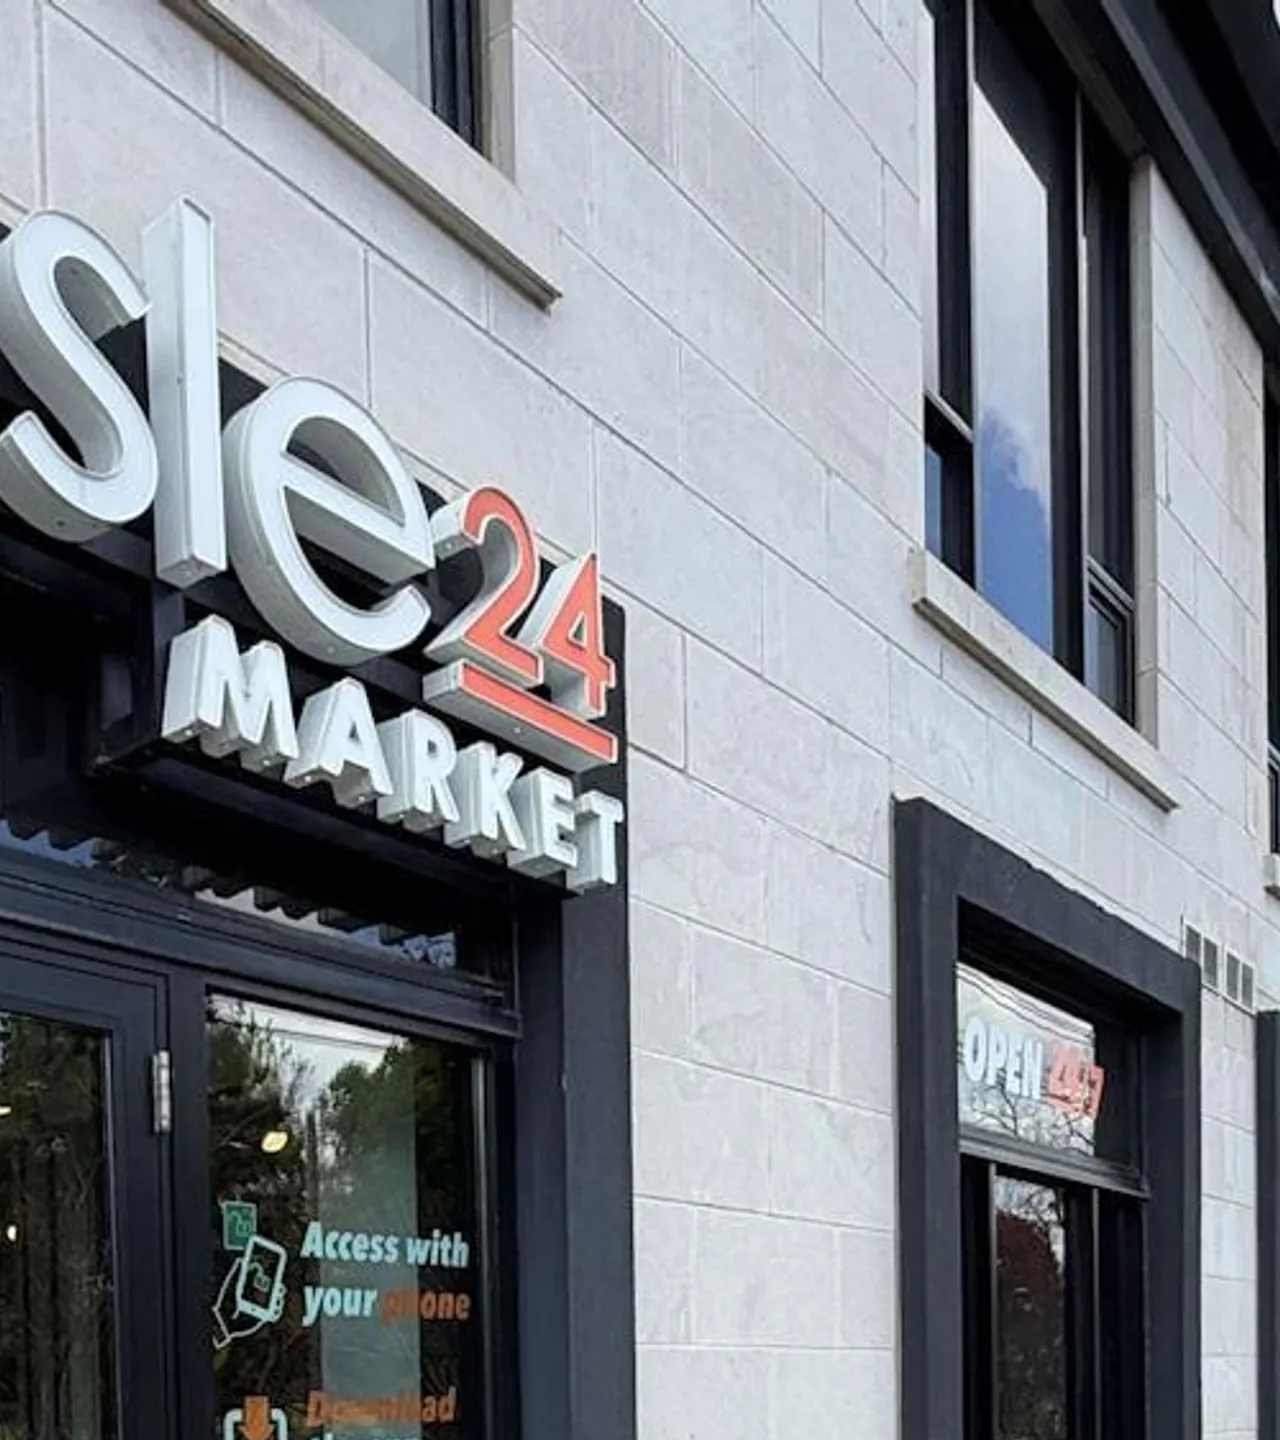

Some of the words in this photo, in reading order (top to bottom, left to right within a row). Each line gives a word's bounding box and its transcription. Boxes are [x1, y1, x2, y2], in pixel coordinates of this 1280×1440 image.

[162, 613, 622, 890] MARKET
[964, 1017, 1044, 1101] OPEN
[300, 1221, 399, 1263] Access
[406, 1229, 469, 1268] with
[301, 1285, 378, 1326] your
[307, 1386, 457, 1427] Dnlad
